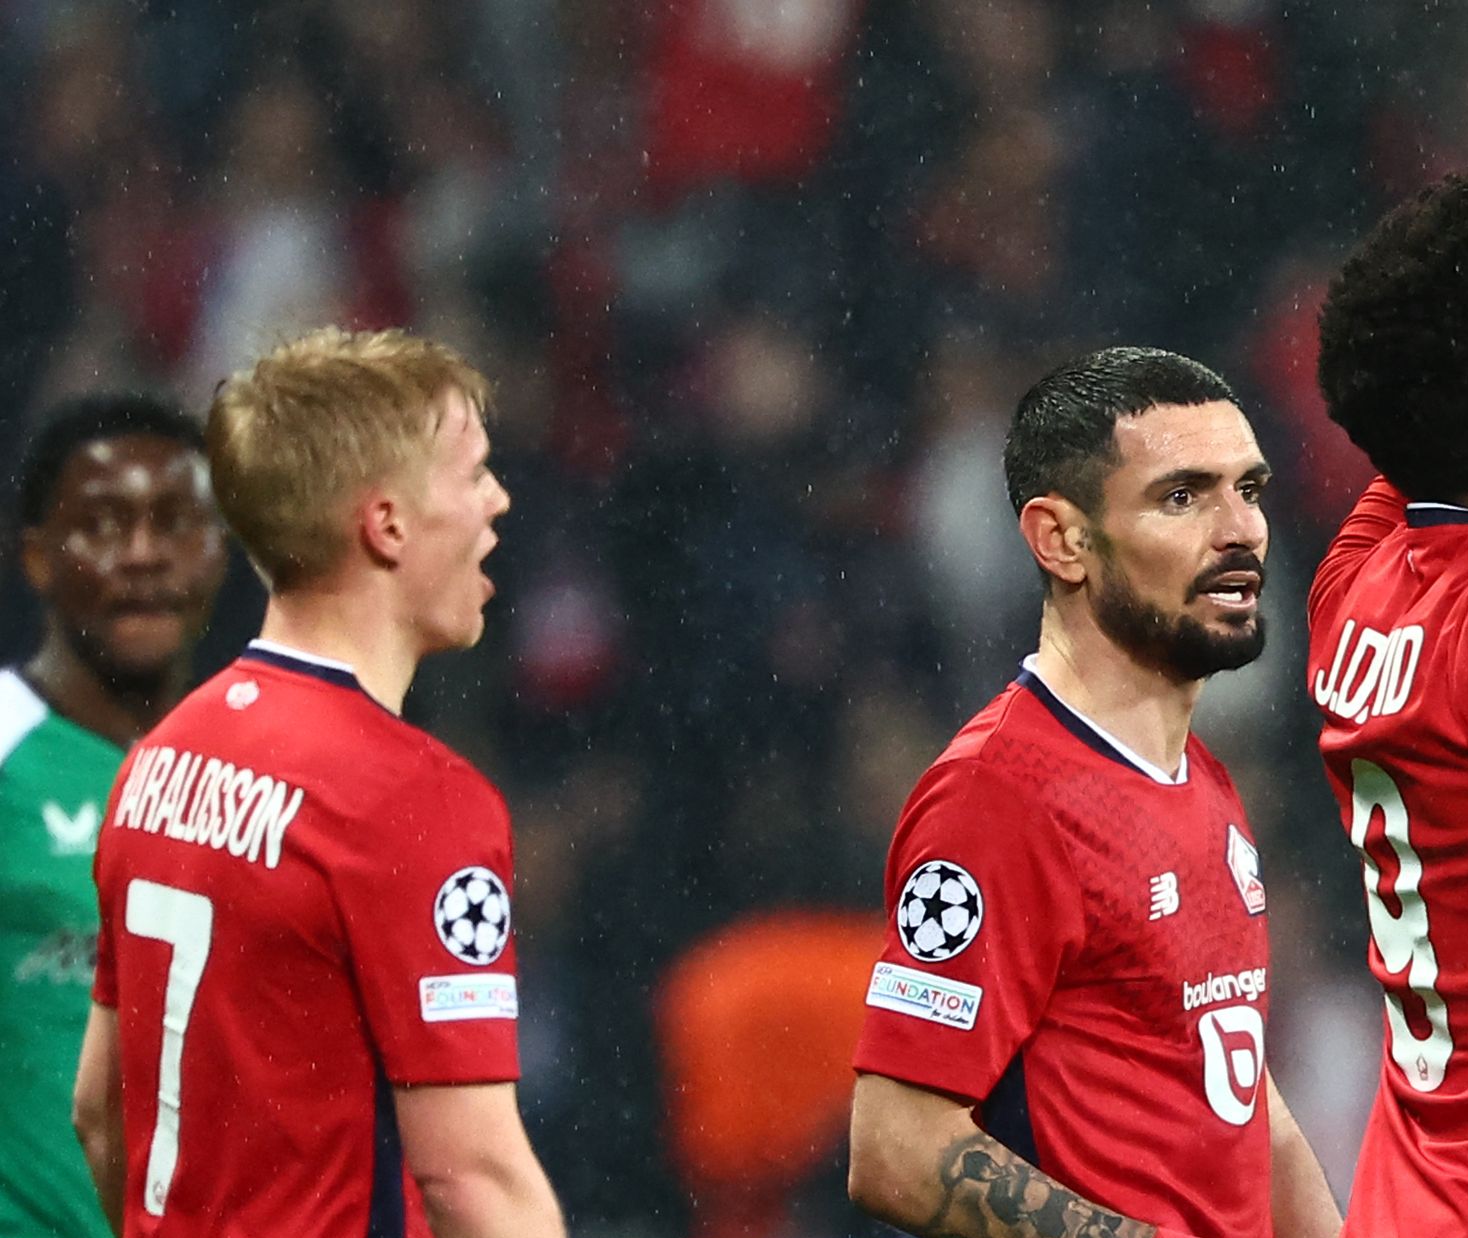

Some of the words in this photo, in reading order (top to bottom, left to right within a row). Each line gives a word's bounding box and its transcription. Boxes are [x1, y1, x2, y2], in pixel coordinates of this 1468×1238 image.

[126, 878, 213, 1216] 7
[1184, 967, 1266, 1010] boulanger
[1351, 757, 1454, 1093] 9
